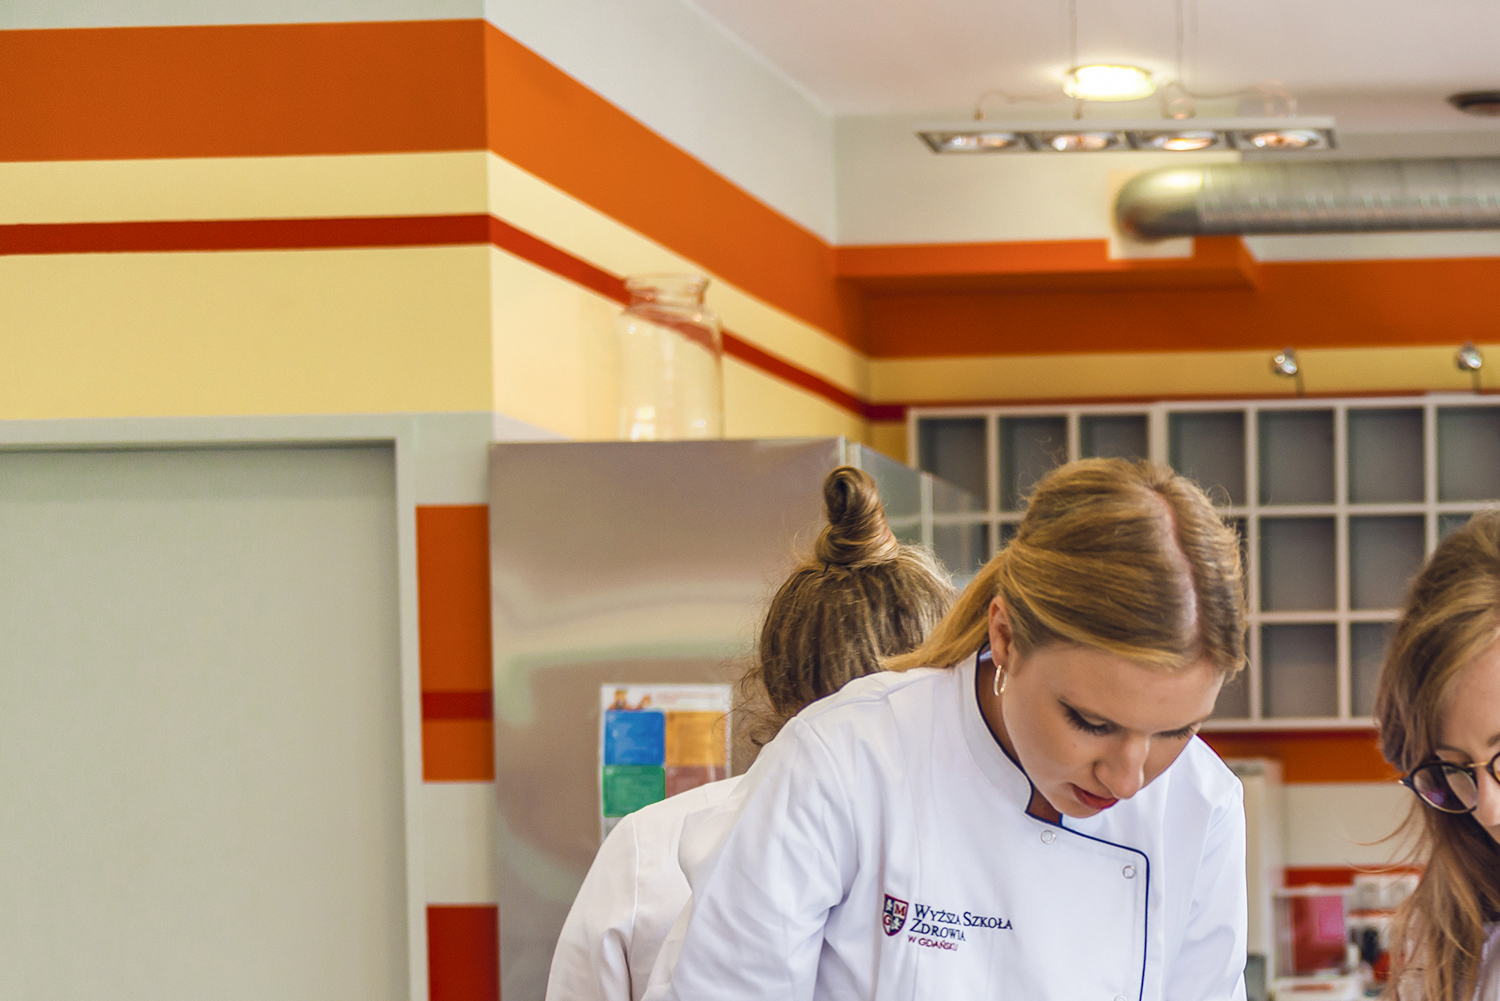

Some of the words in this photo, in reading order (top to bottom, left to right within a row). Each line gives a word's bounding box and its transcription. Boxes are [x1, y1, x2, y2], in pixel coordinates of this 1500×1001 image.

[914, 903, 961, 925] WYŻSZA
[963, 911, 1013, 930] SZKOŁA
[909, 918, 966, 941] ZDROWIA
